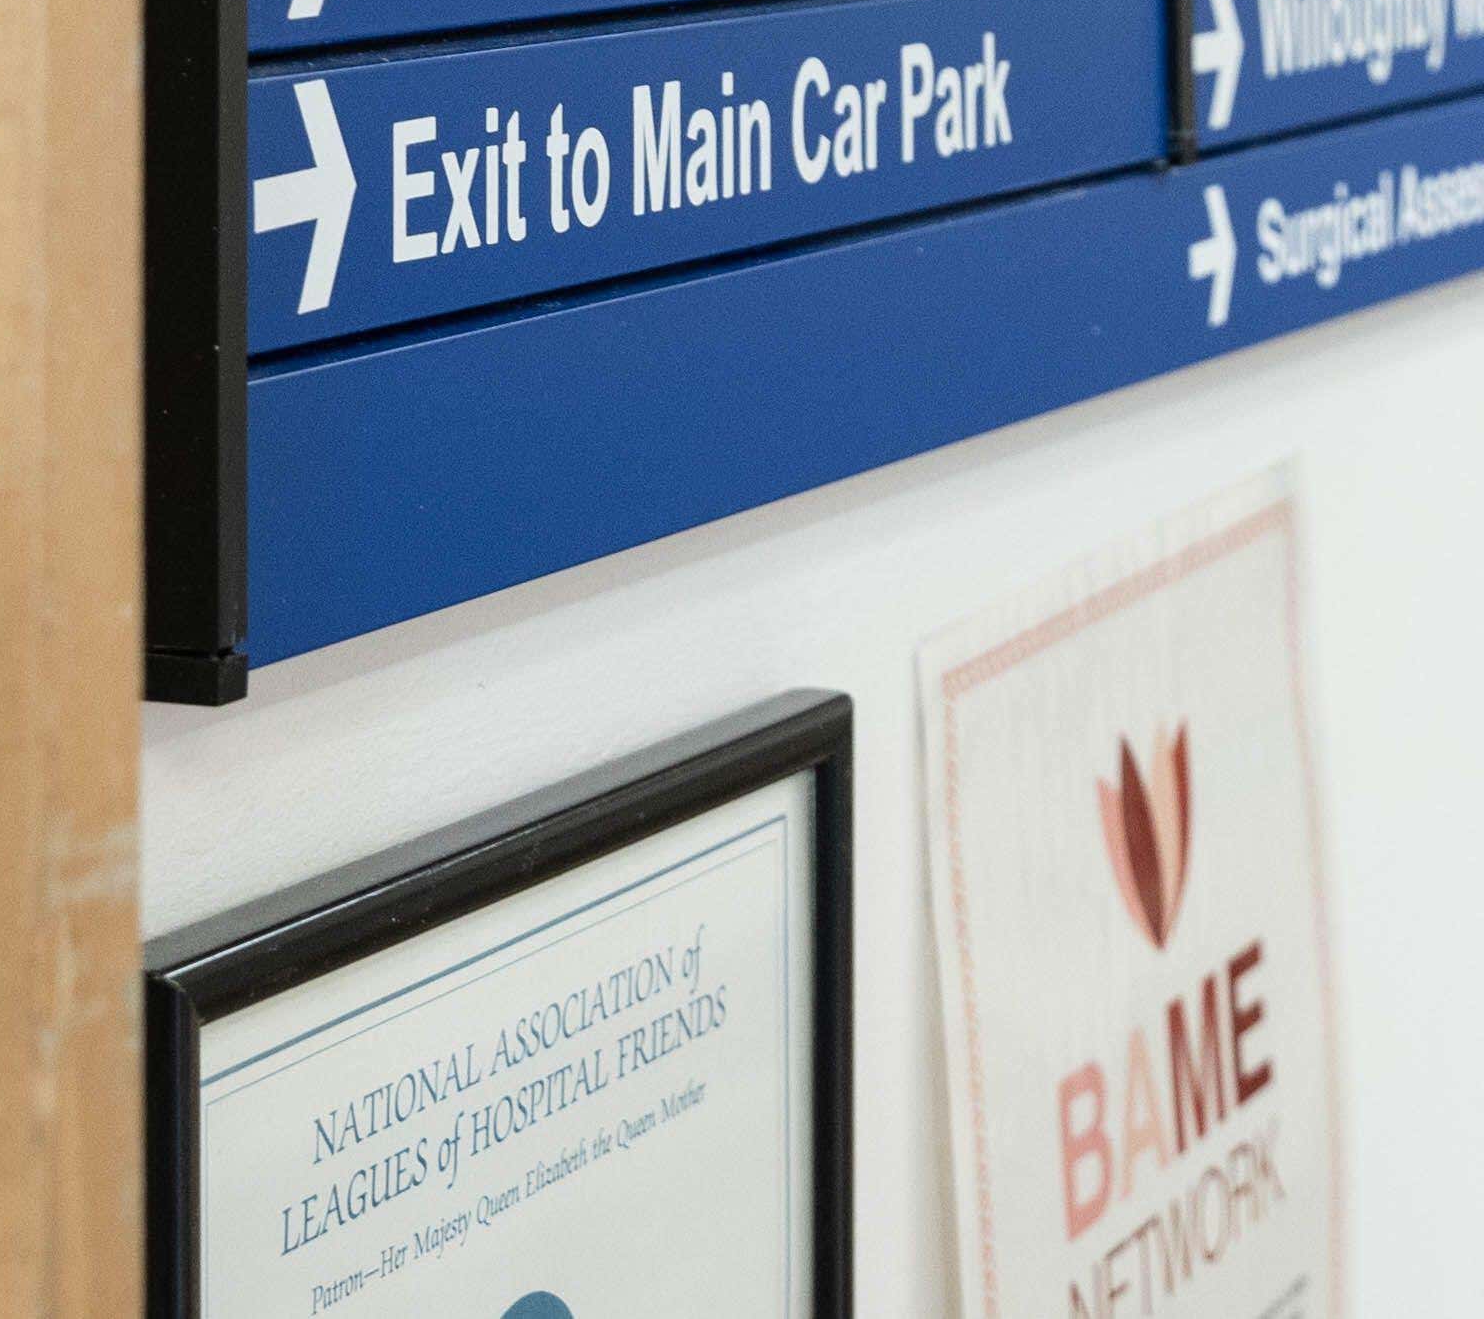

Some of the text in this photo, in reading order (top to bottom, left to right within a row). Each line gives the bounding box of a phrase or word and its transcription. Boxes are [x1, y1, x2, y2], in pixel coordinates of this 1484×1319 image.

[391, 31, 1014, 264] Exit to Main Car Park
[1255, 169, 1395, 289] Surgical
[280, 983, 728, 1257] LEAGUES of HOSPITAL FRIENDS
[312, 923, 706, 1166] NATIONAL ASSOCIATION of
[1056, 937, 1274, 1243] BAME
[412, 1208, 472, 1263] Majesty
[476, 1184, 522, 1226] Queen
[524, 1145, 591, 1200] Elizabeth
[591, 1127, 614, 1161] the
[616, 1111, 658, 1149] Queen
[660, 1079, 708, 1124] Mother
